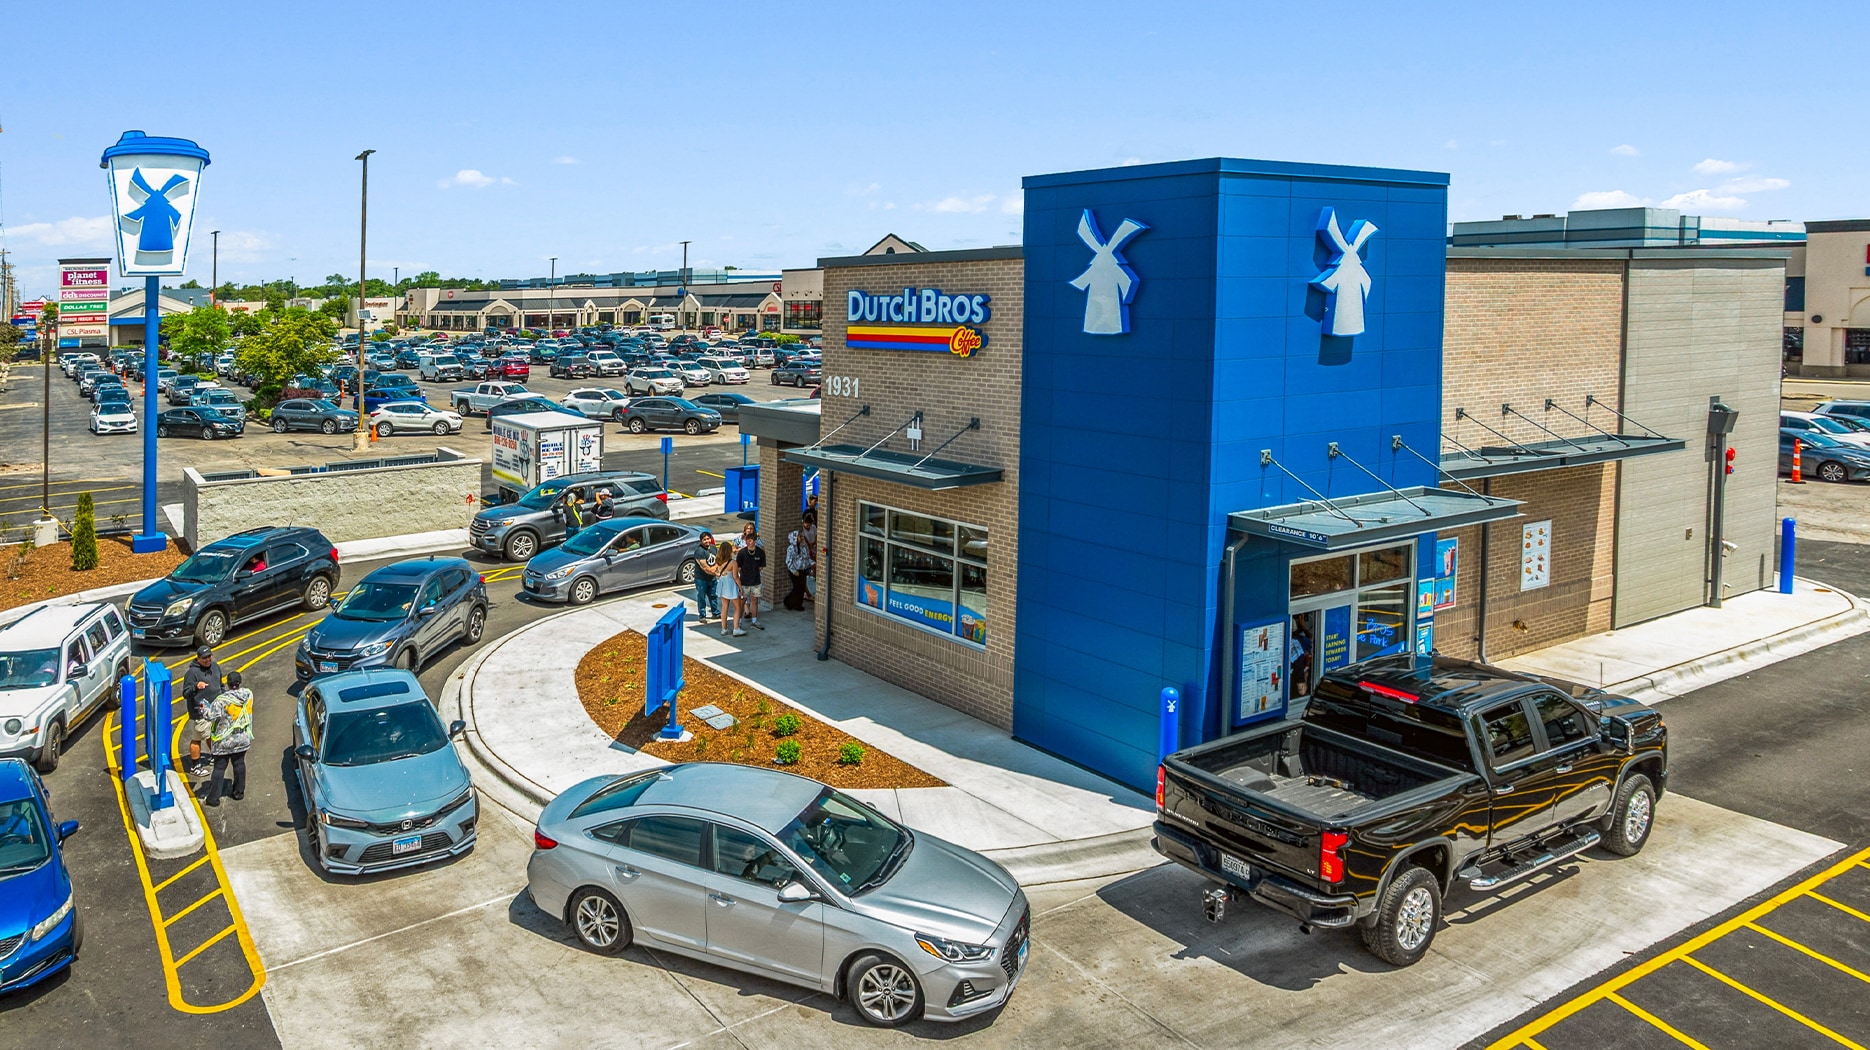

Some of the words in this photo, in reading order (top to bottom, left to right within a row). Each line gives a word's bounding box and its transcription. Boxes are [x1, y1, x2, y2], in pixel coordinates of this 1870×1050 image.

[68, 272, 97, 281] planet
[847, 288, 917, 322] DUTCH
[920, 288, 988, 324] BROS
[951, 328, 982, 356] Coffee
[825, 375, 860, 399] 1931
[1271, 525, 1306, 537] CLEARANCE
[889, 598, 903, 609] FEEL
[904, 603, 924, 615] GOOD
[924, 610, 953, 623] ENERGY
[1366, 617, 1394, 636] Bros
[1369, 634, 1389, 648] Park
